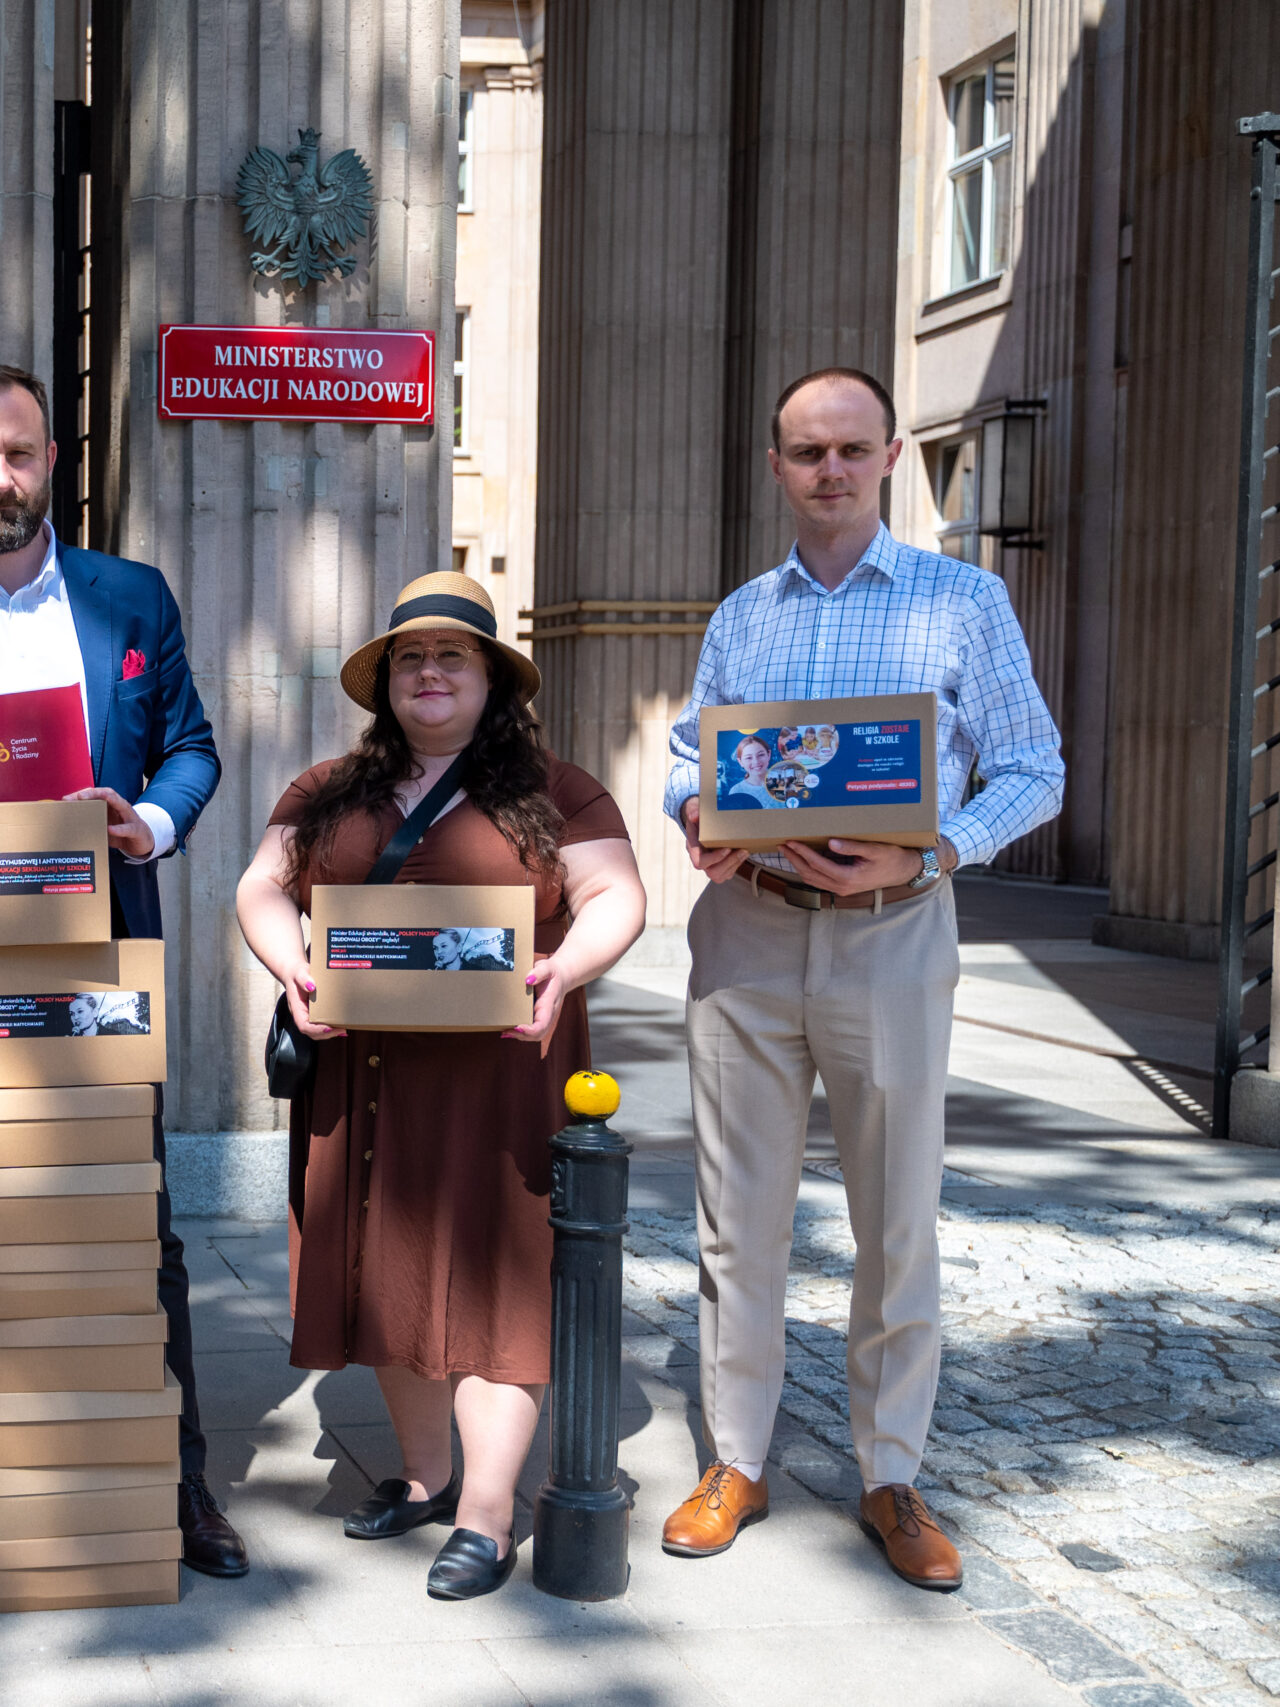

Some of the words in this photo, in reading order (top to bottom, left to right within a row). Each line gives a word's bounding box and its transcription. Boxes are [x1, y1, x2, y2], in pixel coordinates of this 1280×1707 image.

[214, 345, 384, 369] MINISTERSTWO
[170, 377, 280, 404] EDUKACJI
[287, 379, 424, 407] NARODOWEJ
[853, 726, 879, 735] RELIGIA
[881, 724, 909, 733] ZOSTAJE
[10, 737, 37, 745] Centrum
[865, 737, 872, 745] W
[873, 735, 900, 744] SZKOLE
[12, 745, 27, 753] Życia
[42, 857, 91, 865] ANTYRODZINNEJ
